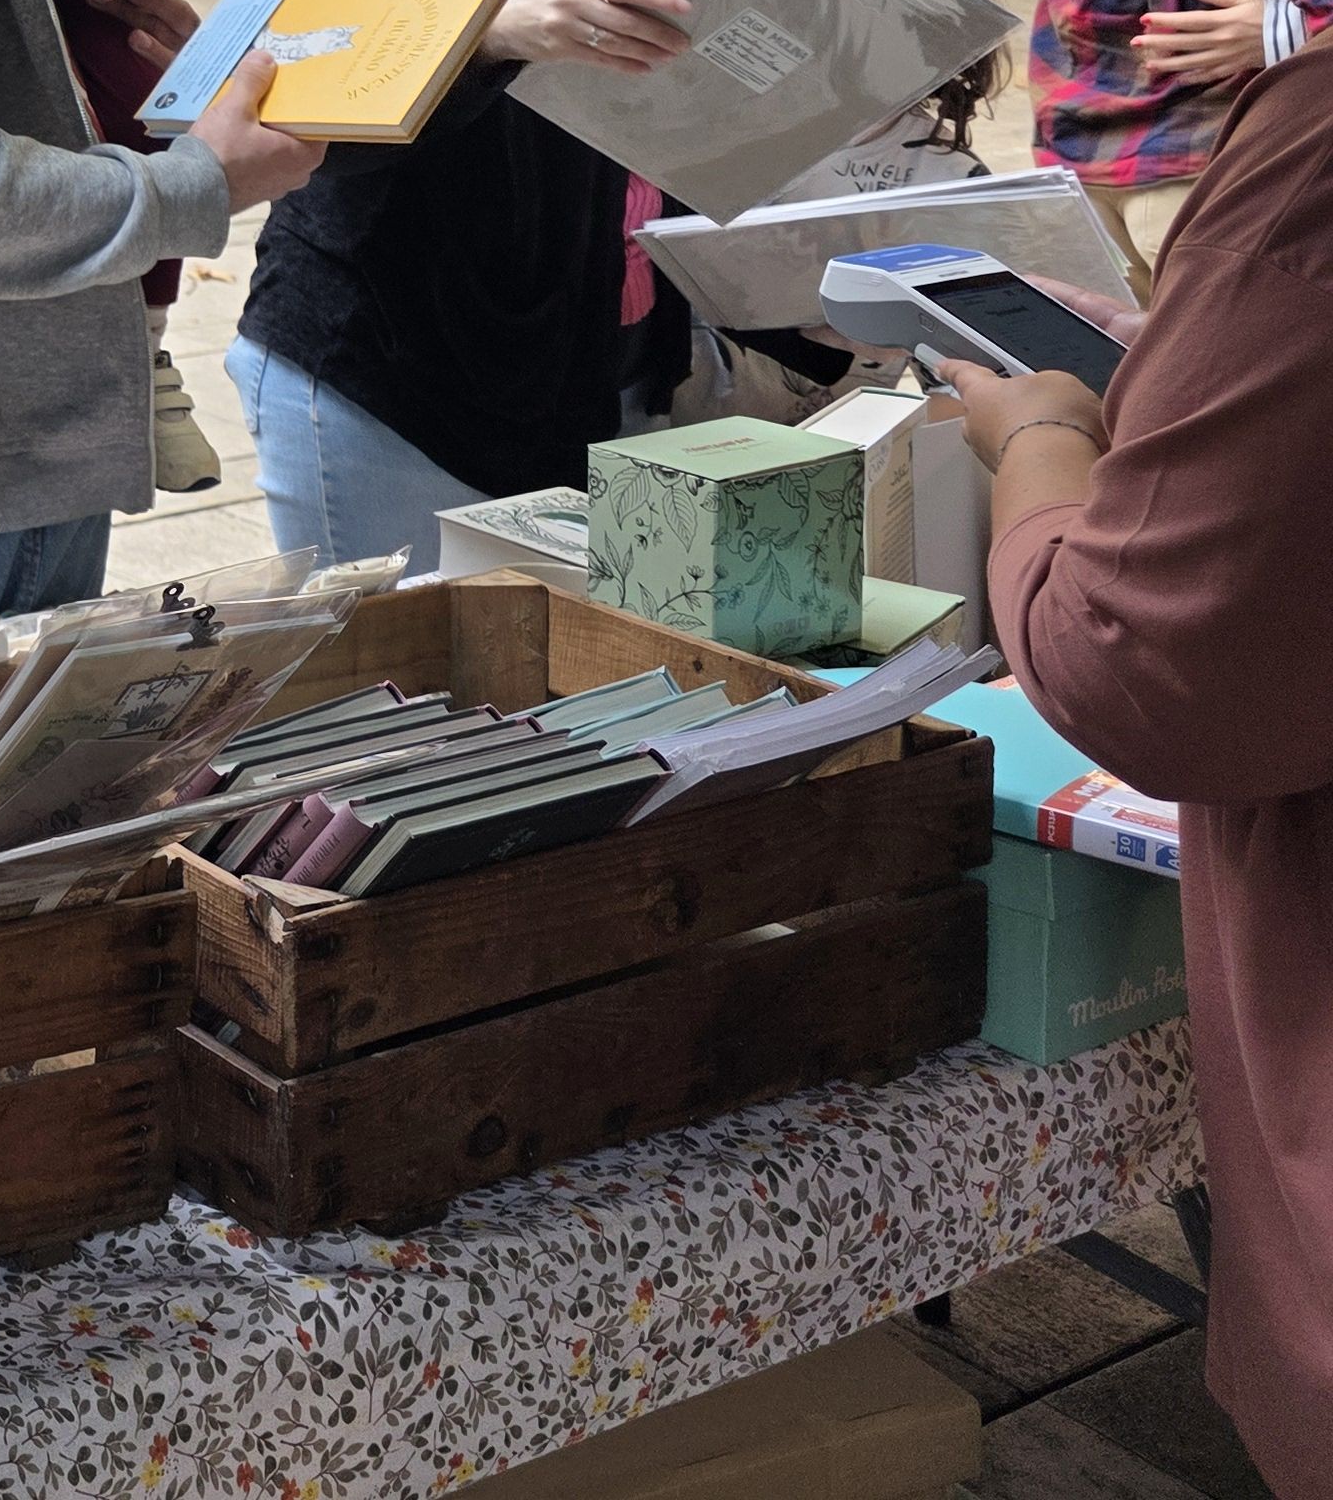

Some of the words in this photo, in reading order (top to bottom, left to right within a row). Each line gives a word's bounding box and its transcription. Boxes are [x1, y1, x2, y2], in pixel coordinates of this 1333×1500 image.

[366, 19, 410, 71] HUMANO
[833, 160, 915, 183] JUNGLE
[1119, 835, 1131, 856] 30
[1068, 976, 1148, 1029] Moulin
